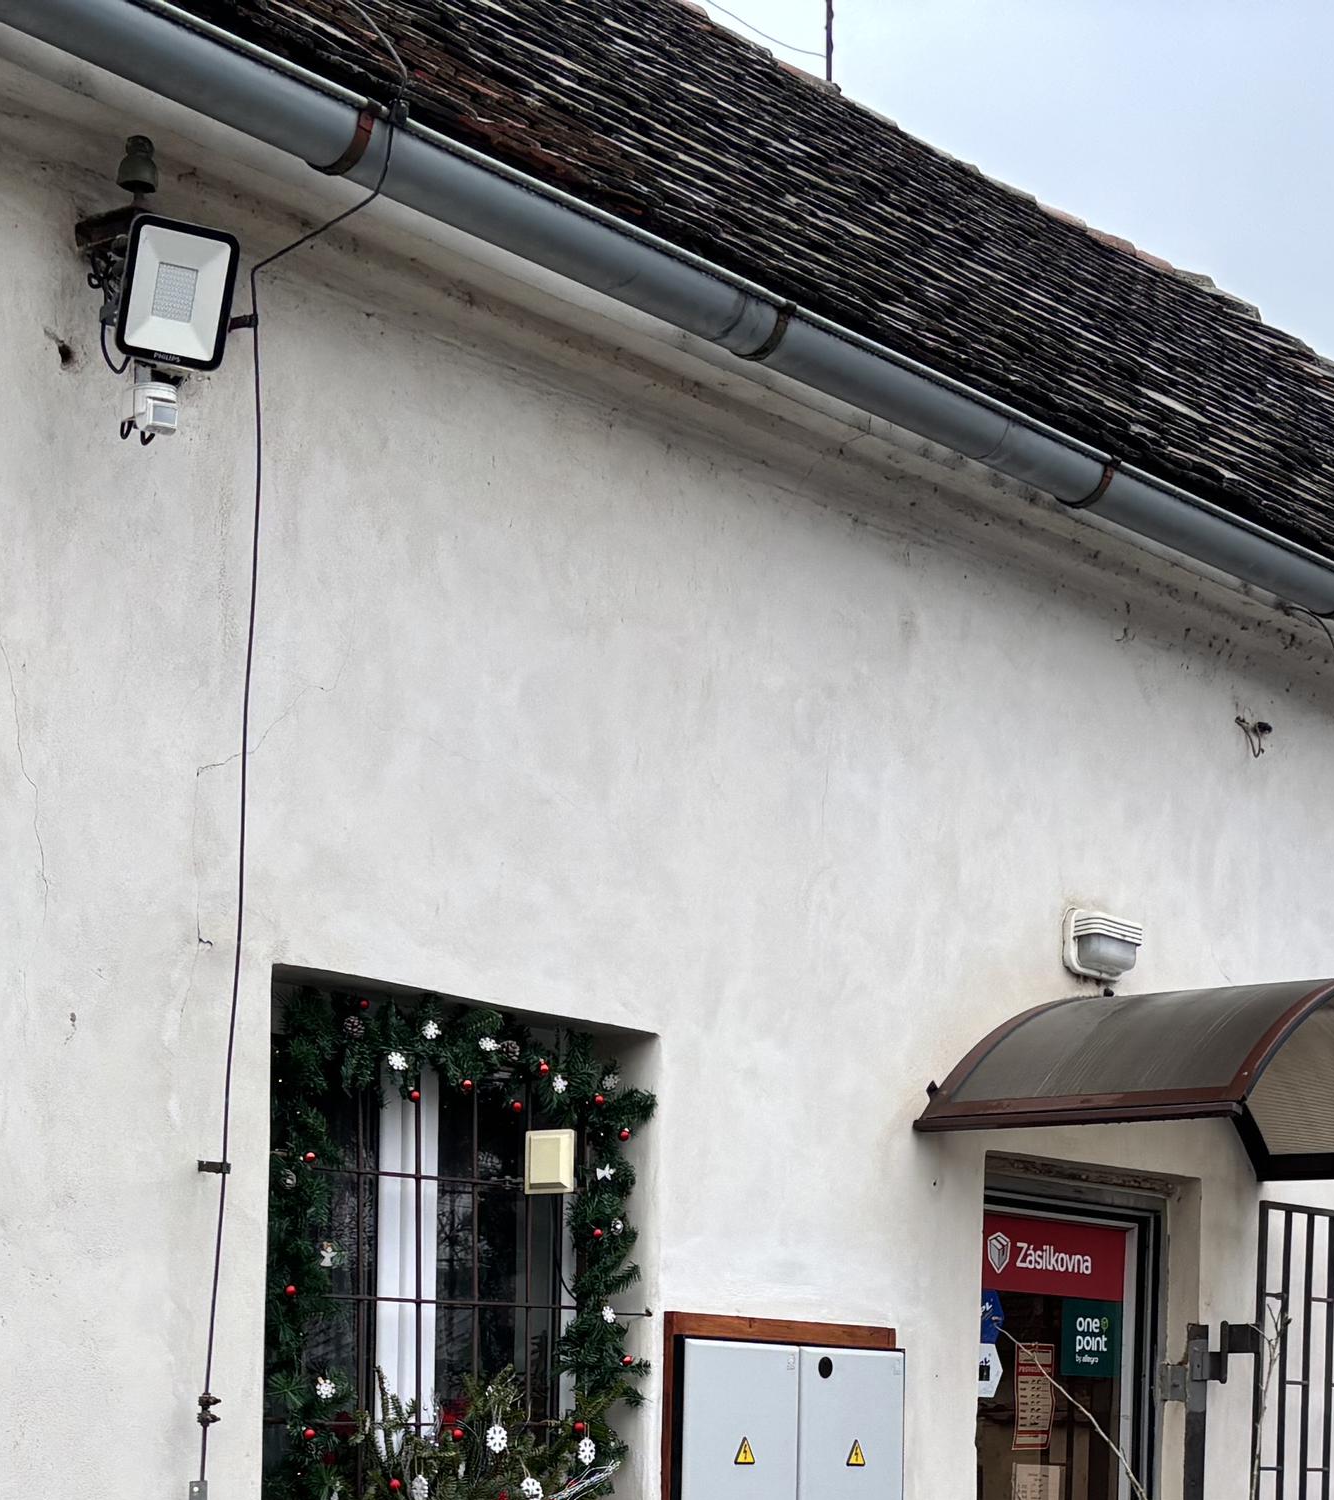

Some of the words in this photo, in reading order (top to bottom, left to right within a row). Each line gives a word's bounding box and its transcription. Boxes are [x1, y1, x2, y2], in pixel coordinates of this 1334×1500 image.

[154, 351, 181, 363] PHILIPS
[1016, 1241, 1092, 1274] Zásilkovna
[1076, 1317, 1100, 1333] one
[1076, 1335, 1107, 1352] point
